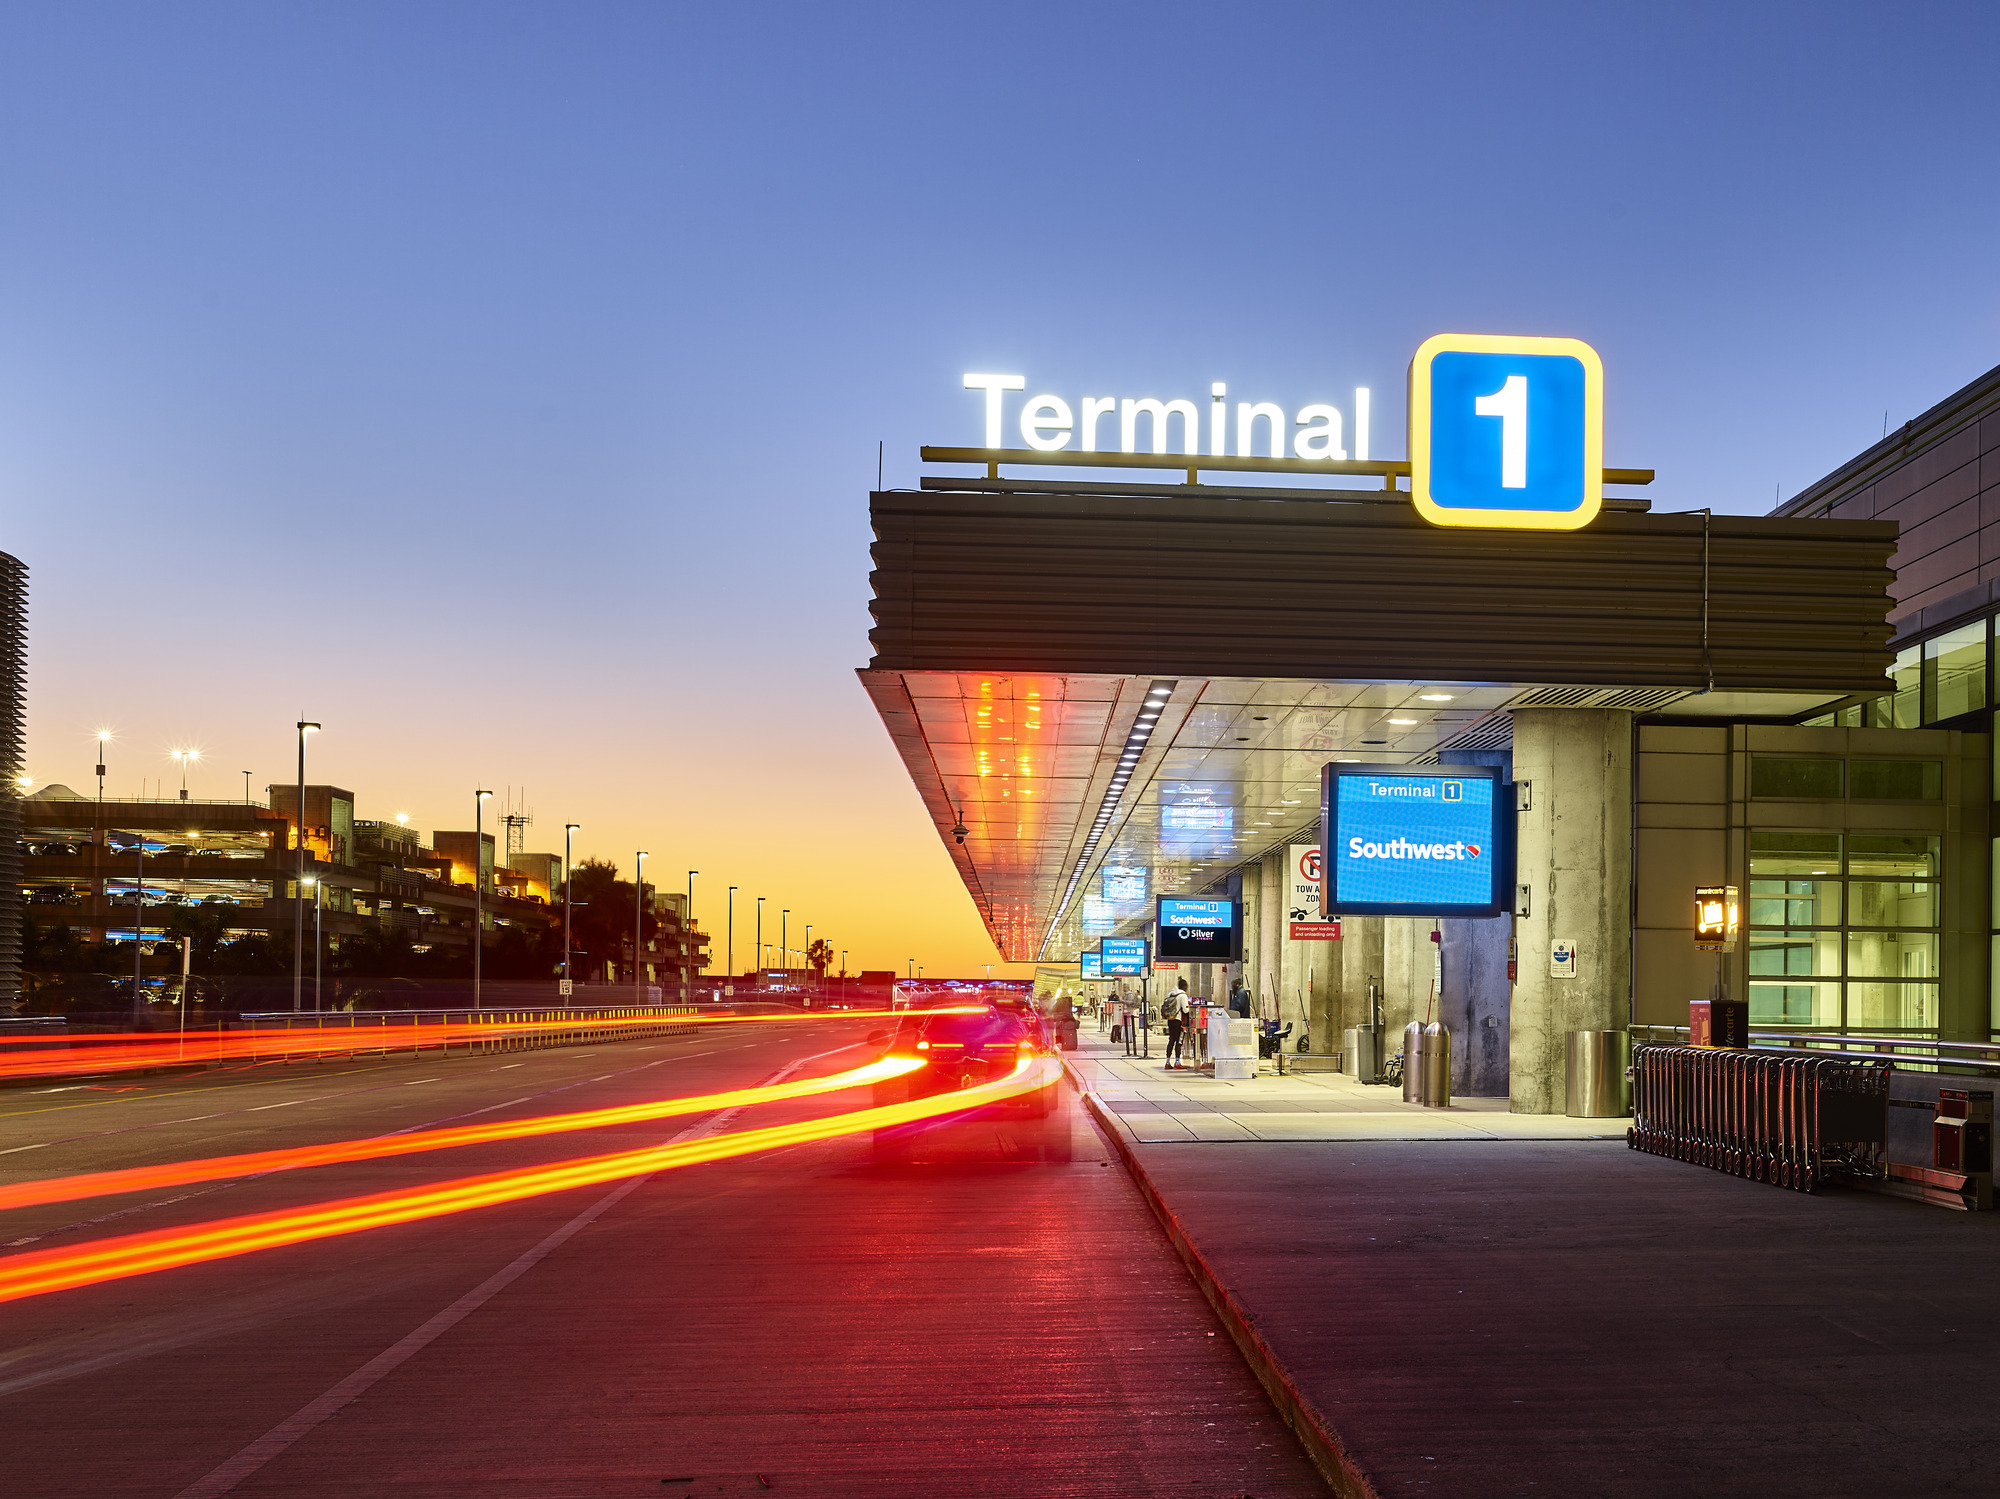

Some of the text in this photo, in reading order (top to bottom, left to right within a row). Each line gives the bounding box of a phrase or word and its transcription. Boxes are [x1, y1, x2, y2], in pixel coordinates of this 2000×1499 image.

[963, 373, 1527, 489] Terminal 1
[1369, 782, 1454, 798] Terminal 1
[1349, 837, 1465, 860] Southwest
[1296, 885, 1312, 893] TOW
[1306, 894, 1320, 902] ZON
[1170, 915, 1216, 924] Southwest
[1111, 964, 1135, 973] Alaska
